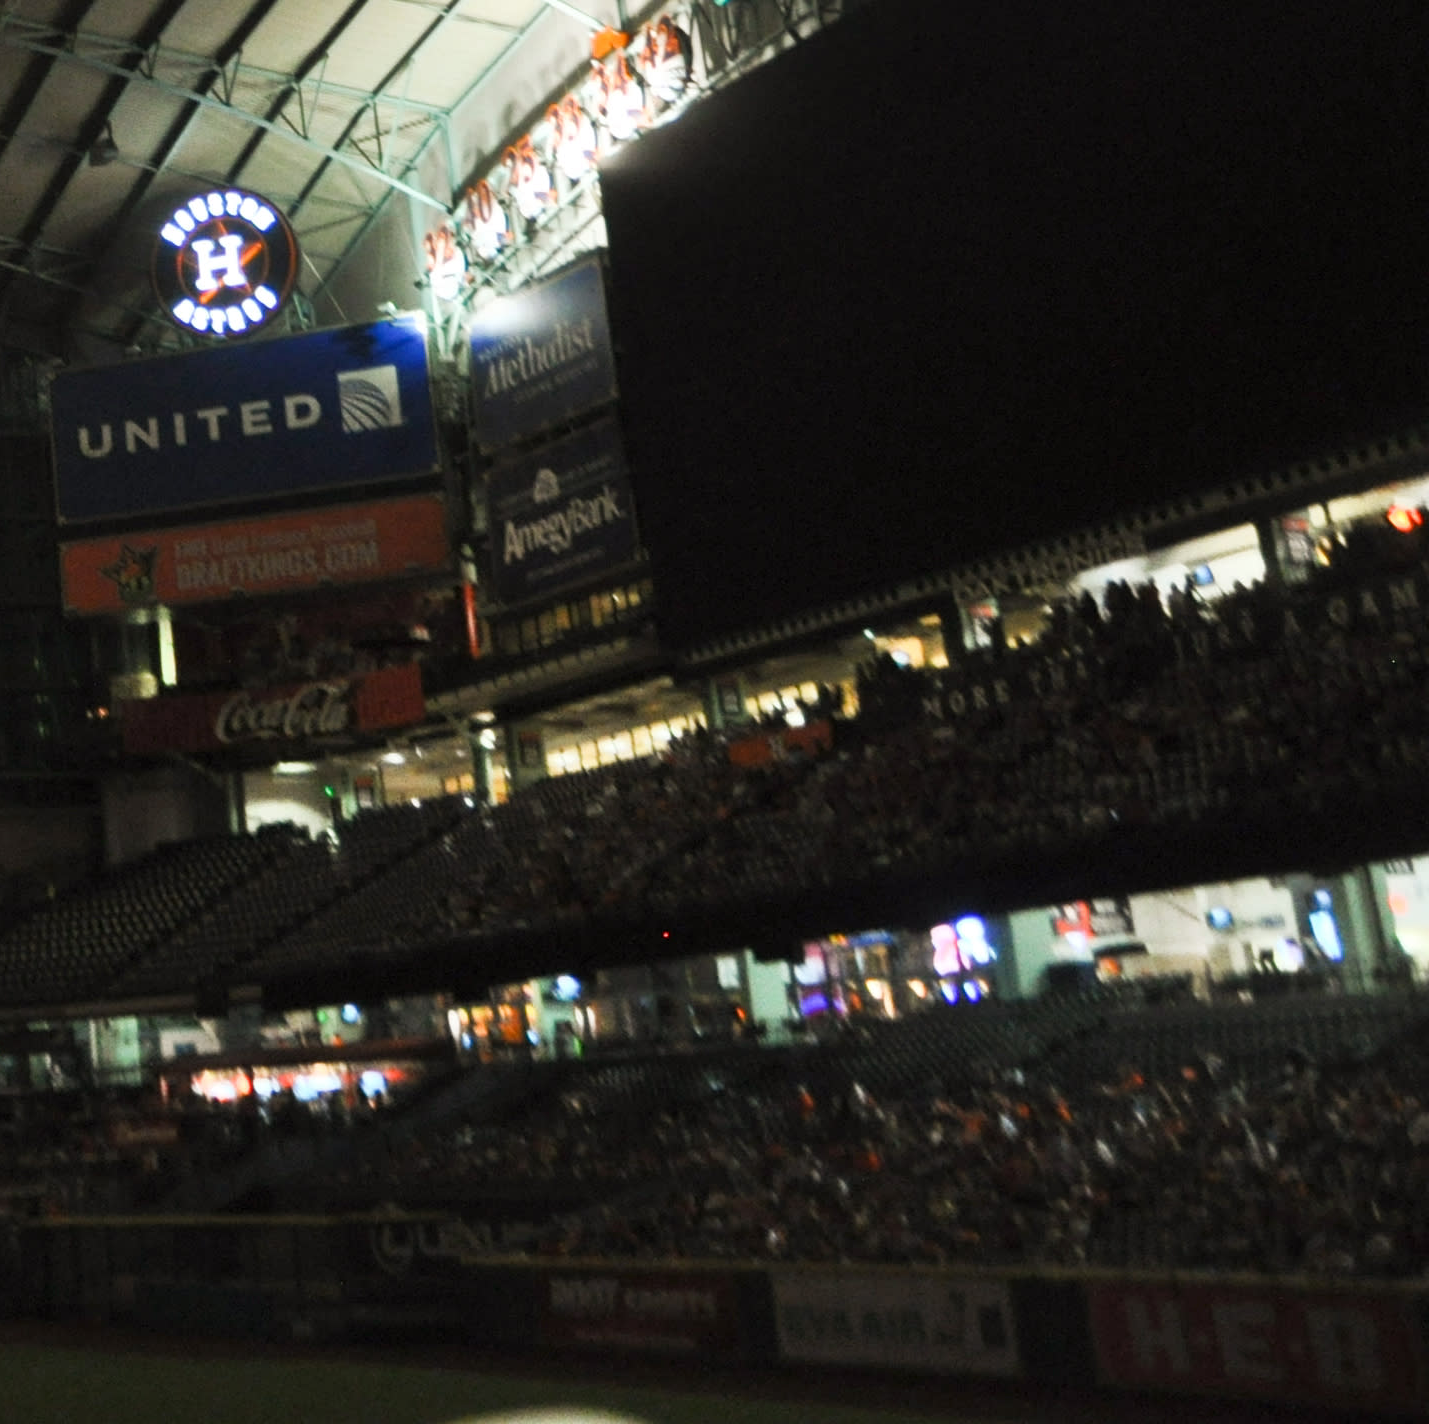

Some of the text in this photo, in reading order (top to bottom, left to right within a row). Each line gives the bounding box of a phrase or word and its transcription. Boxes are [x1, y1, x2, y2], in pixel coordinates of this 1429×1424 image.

[160, 190, 277, 247] HOUSTON
[191, 233, 247, 292] H
[172, 284, 279, 334] ASTROS
[78, 393, 323, 459] UNITED
[502, 484, 625, 566] AmegyBank
[175, 540, 379, 590] DRAFTKINGS.COM
